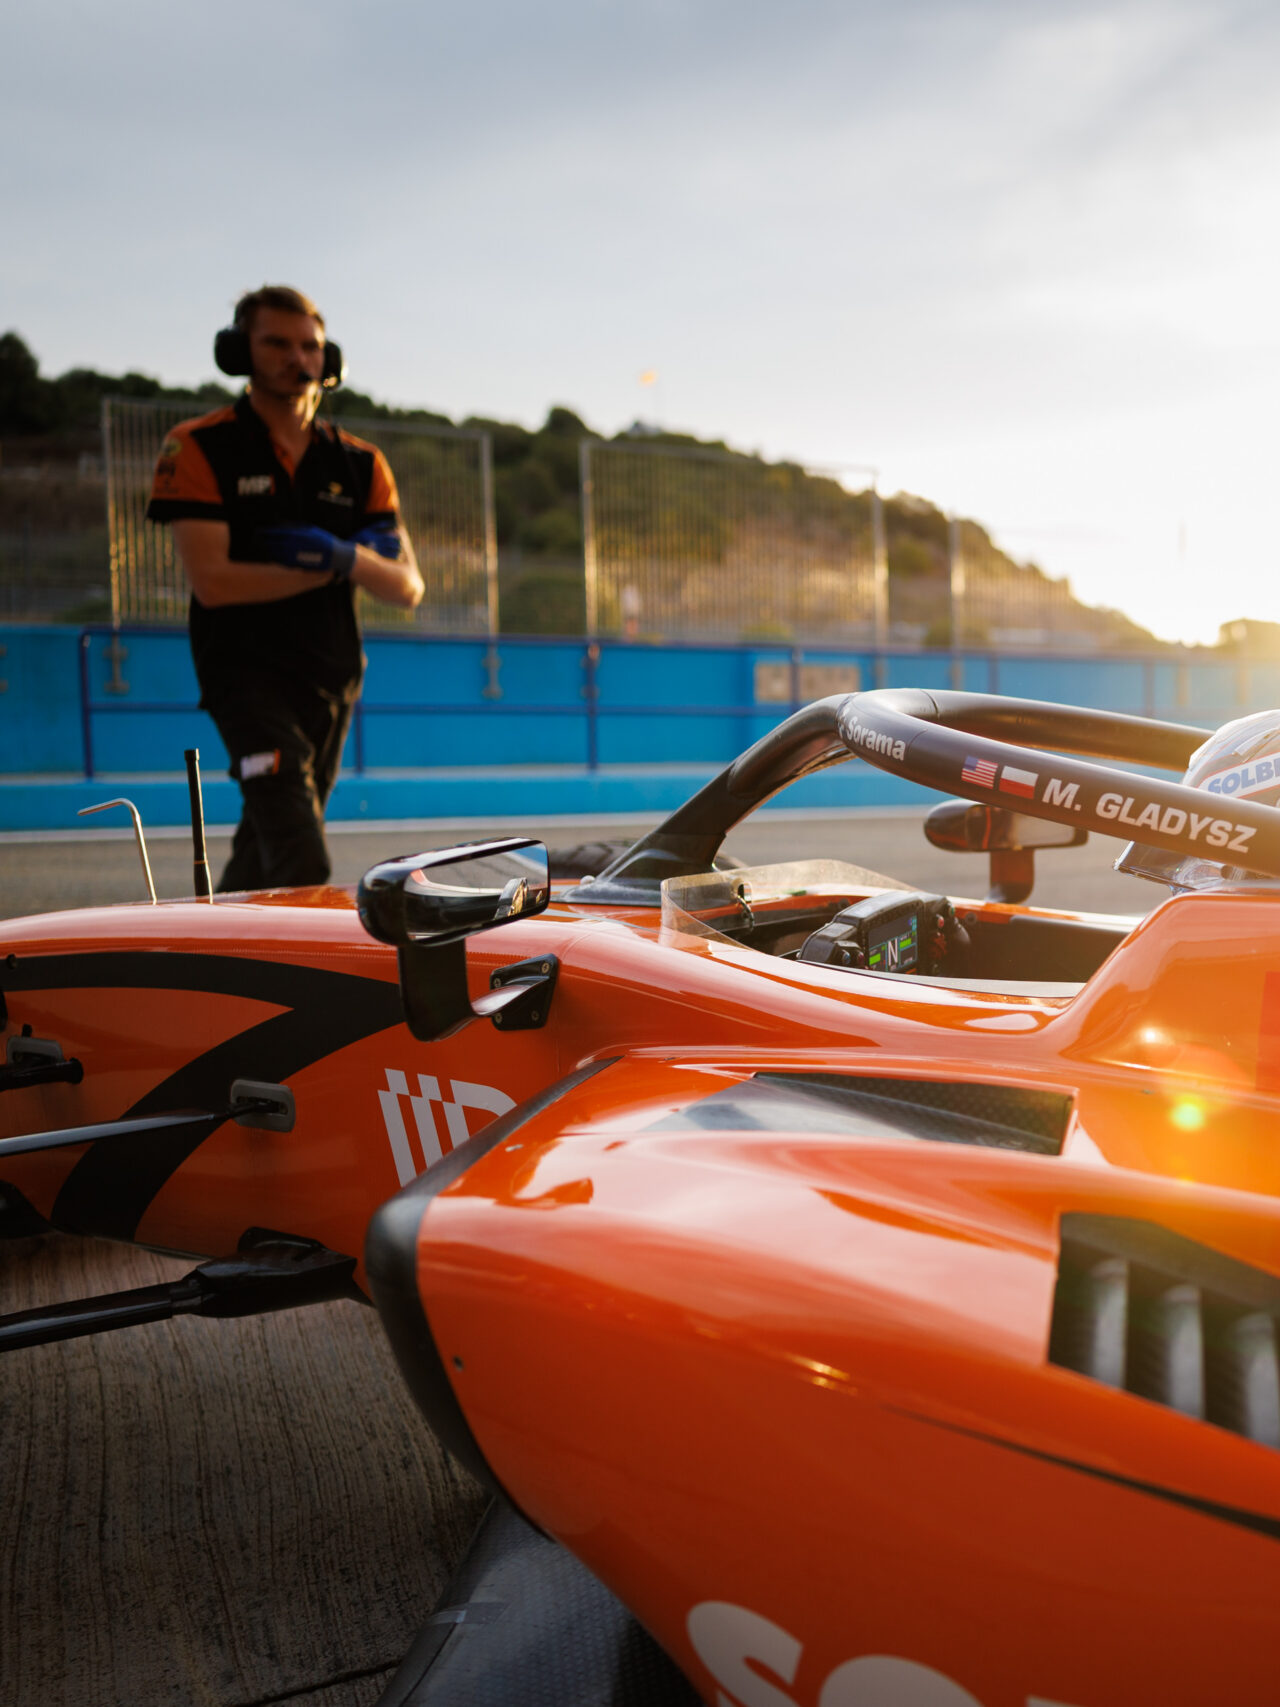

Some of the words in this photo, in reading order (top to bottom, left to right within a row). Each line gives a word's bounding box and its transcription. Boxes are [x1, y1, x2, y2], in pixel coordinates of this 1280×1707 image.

[846, 716, 906, 761] Sorama
[1042, 778, 1081, 811] M.
[1096, 793, 1257, 853] GLADYSZ
[887, 937, 898, 967] N
